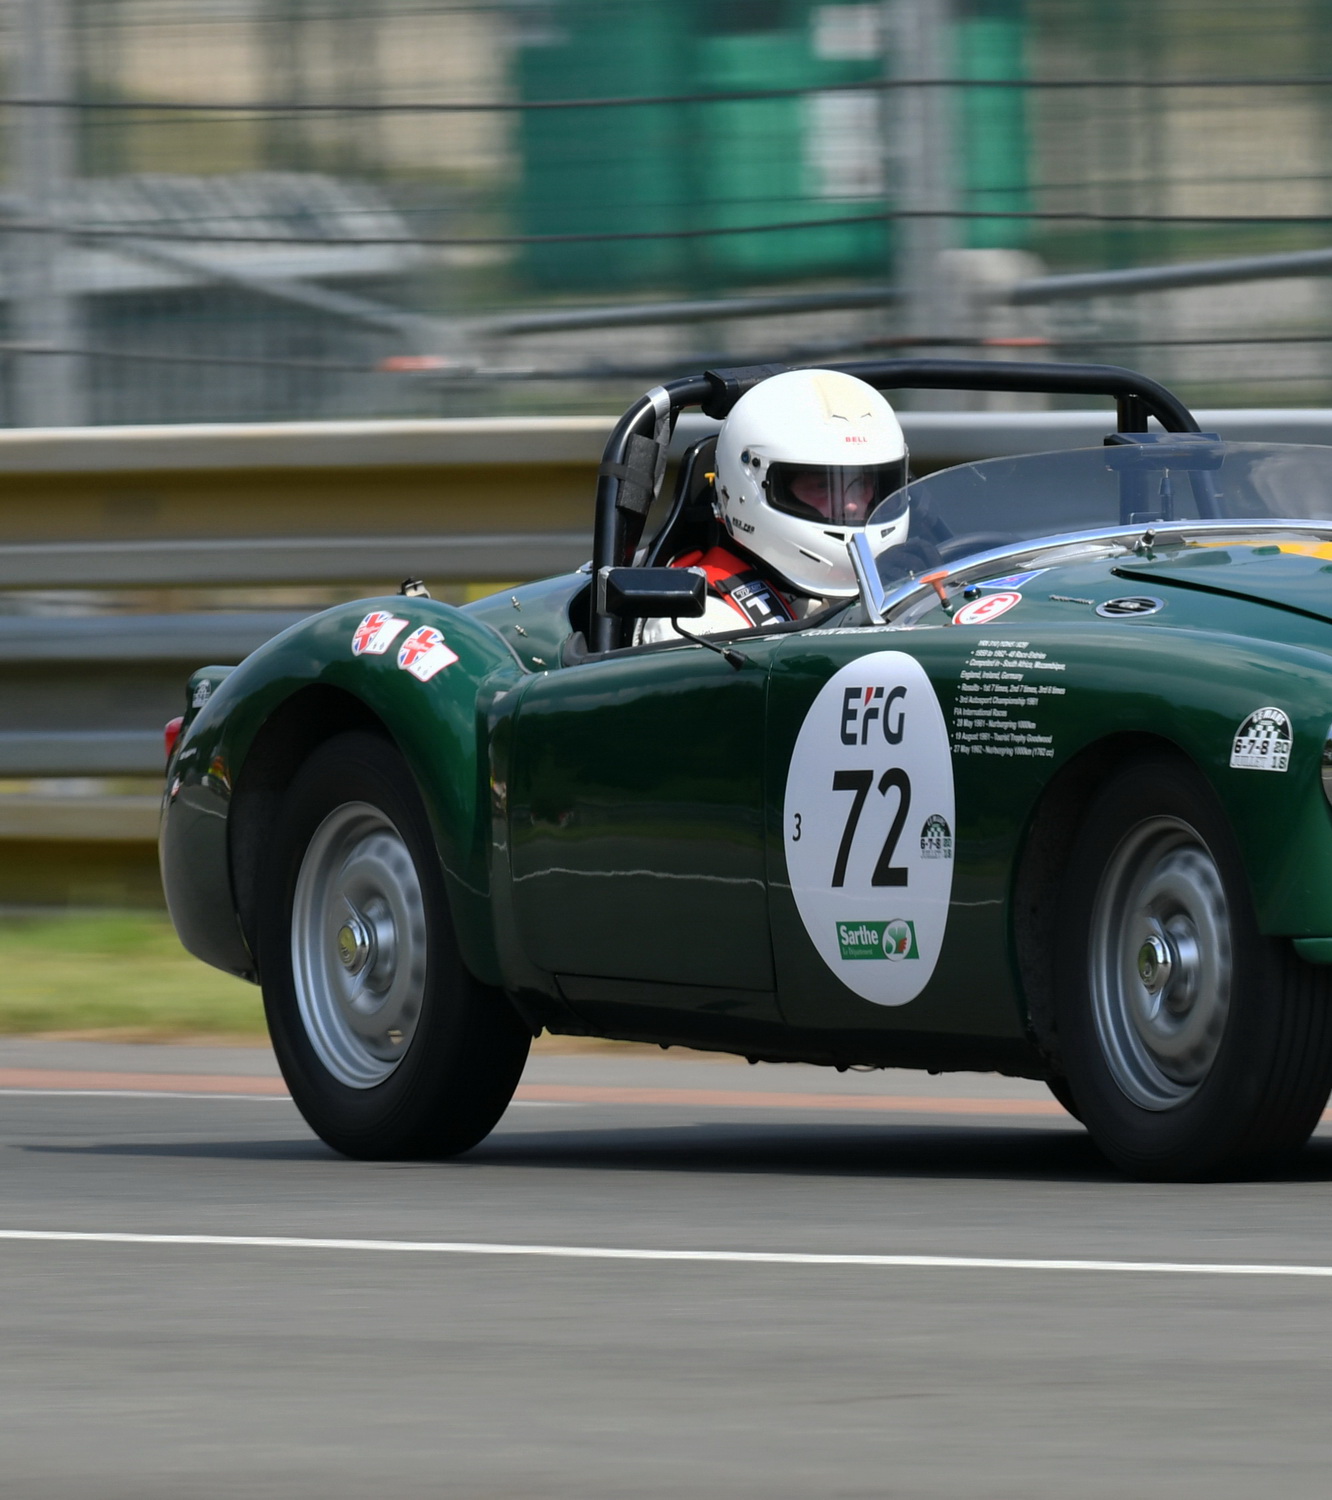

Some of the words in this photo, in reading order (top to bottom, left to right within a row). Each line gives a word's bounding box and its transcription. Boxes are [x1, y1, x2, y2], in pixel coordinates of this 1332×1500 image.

[972, 597, 1009, 614] E
[840, 685, 908, 746] EFG
[1234, 739, 1270, 755] 6-7-8
[1273, 741, 1290, 754] 20
[792, 812, 802, 842] 3
[831, 767, 912, 888] 72
[840, 925, 879, 946] Sarthe
